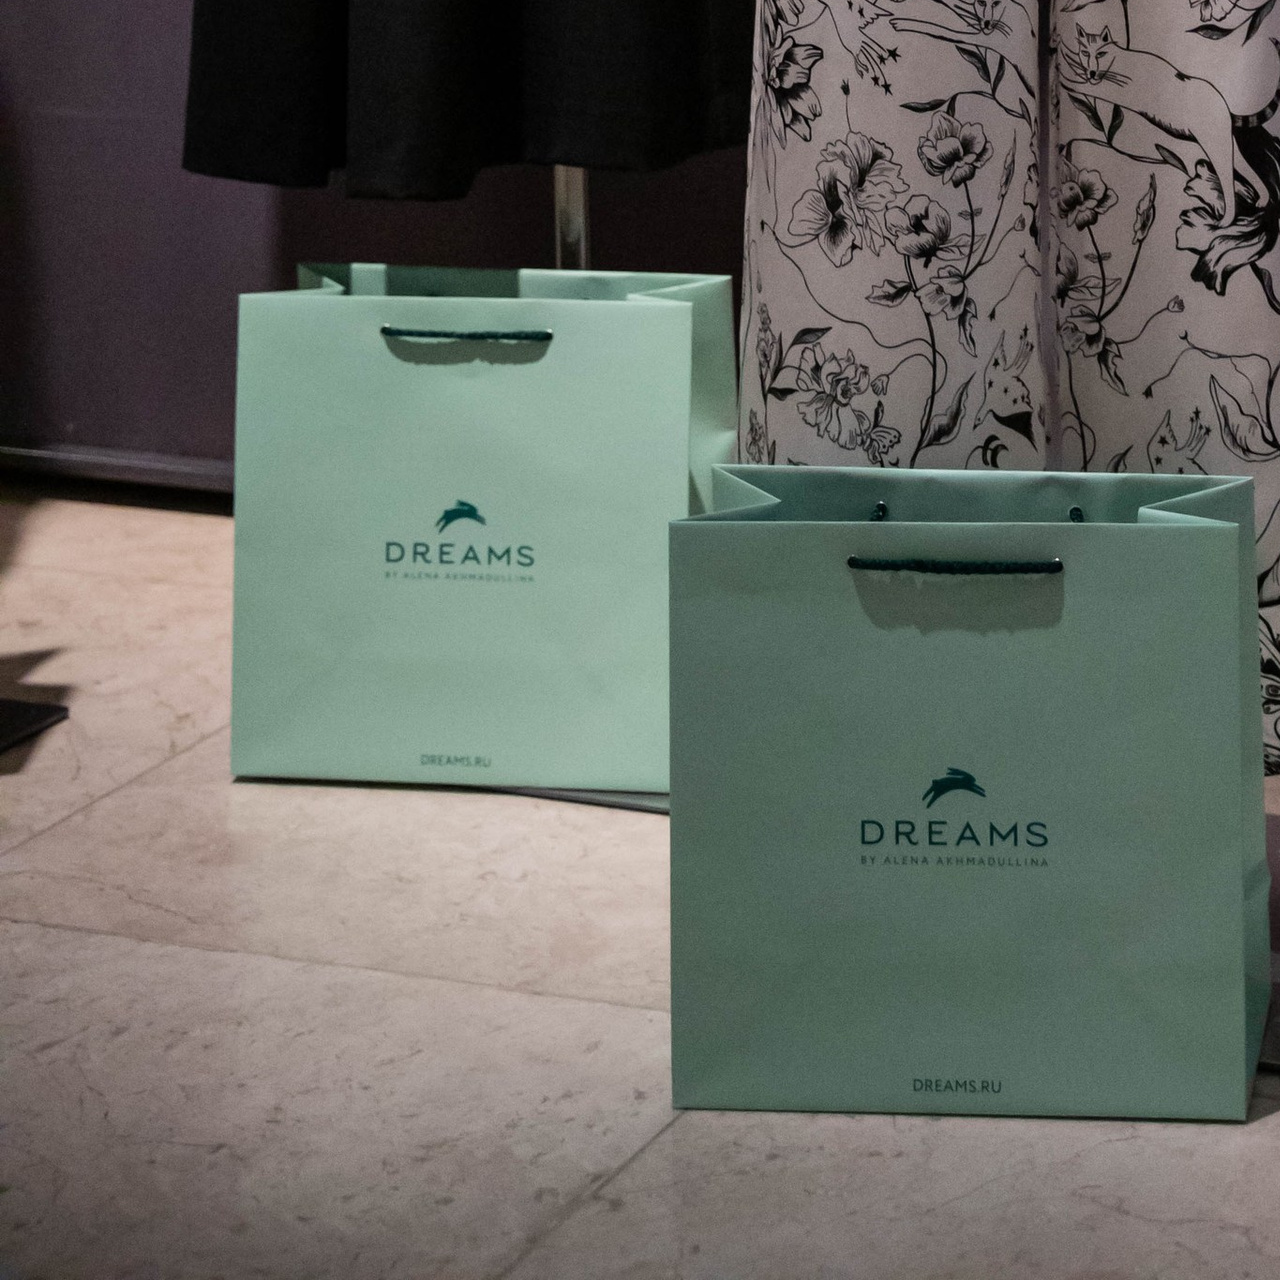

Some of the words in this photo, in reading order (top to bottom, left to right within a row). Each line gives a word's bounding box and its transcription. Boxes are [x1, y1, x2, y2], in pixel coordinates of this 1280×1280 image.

[385, 541, 535, 567] DREAMS
[860, 819, 1049, 848] DREAMS
[860, 855, 876, 865] BY
[884, 856, 929, 866] ALENA
[913, 1079, 1002, 1094] DREAMS.RU
